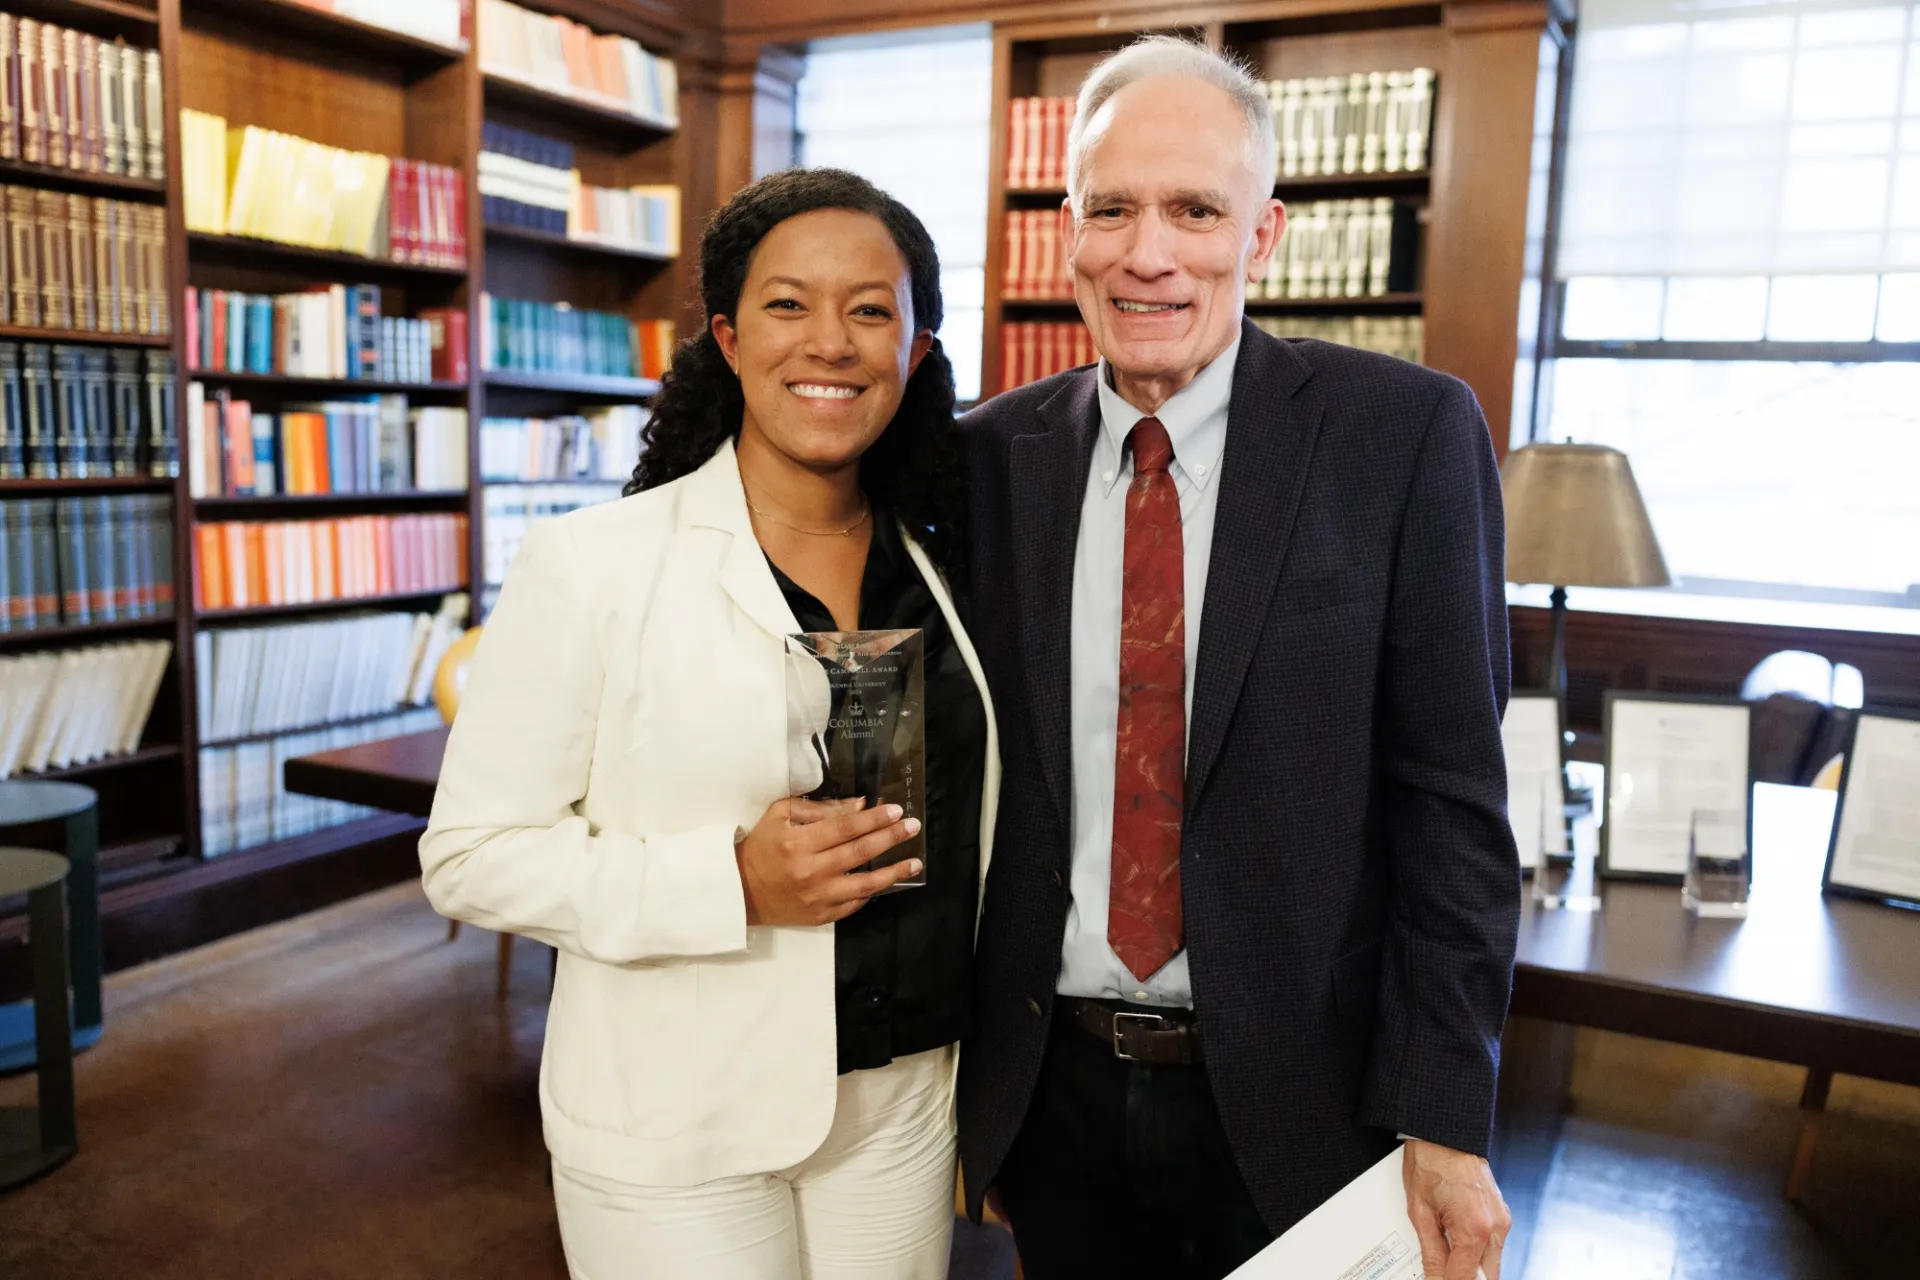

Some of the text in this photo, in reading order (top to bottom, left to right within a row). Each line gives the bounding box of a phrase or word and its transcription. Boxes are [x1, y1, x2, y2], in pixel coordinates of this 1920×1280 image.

[830, 667, 870, 675] CAMLL
[829, 718, 884, 728] COLUMBIA
[841, 729, 874, 739] Alumni
